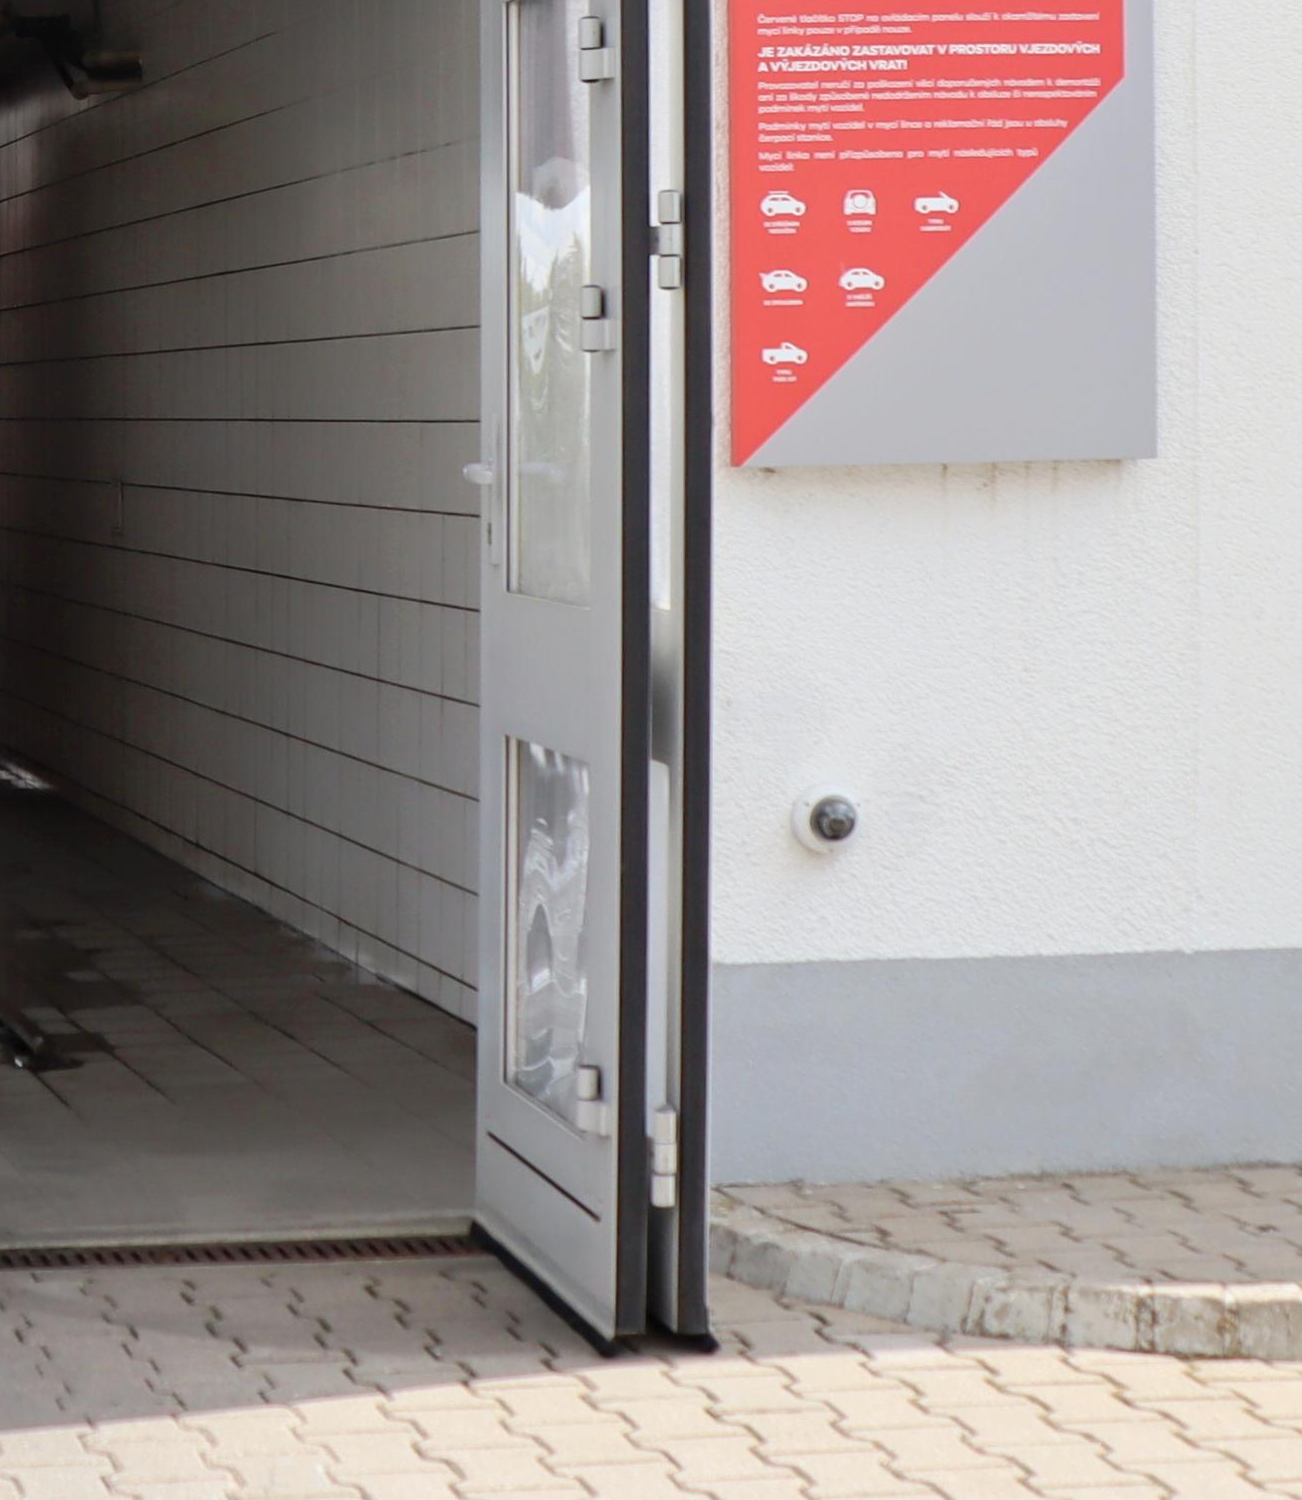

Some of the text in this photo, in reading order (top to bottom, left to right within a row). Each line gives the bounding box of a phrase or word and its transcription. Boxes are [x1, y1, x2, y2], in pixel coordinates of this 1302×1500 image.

[758, 46, 774, 58] JE
[777, 43, 850, 57] ZAKÁZÁNO
[853, 44, 935, 56] ZASTAVOVAT
[937, 44, 947, 54] V
[949, 44, 1017, 55] PROSTORU
[758, 62, 768, 72] A
